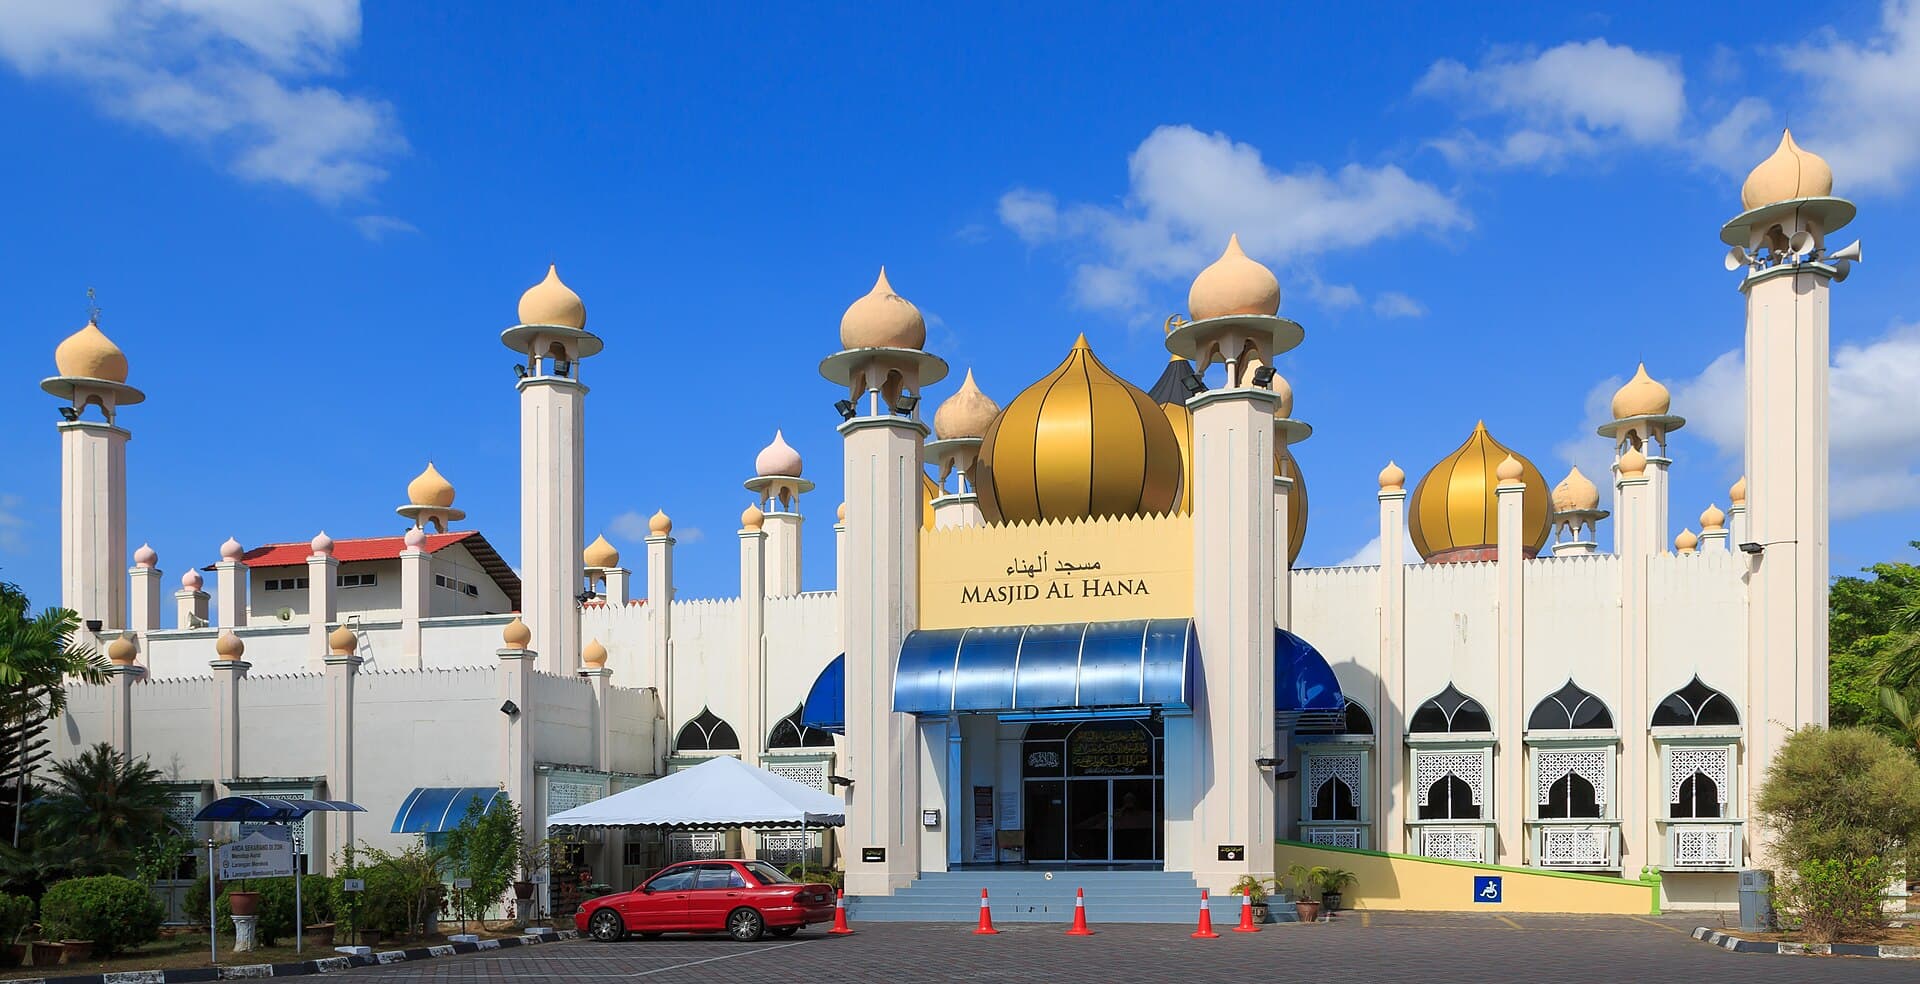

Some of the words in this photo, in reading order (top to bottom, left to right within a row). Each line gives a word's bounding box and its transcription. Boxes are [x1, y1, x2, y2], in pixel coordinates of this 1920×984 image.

[1054, 559, 1101, 576] مسجد
[960, 584, 1040, 606] MASJID
[1045, 580, 1074, 600] AL
[1082, 578, 1150, 598] HANA
